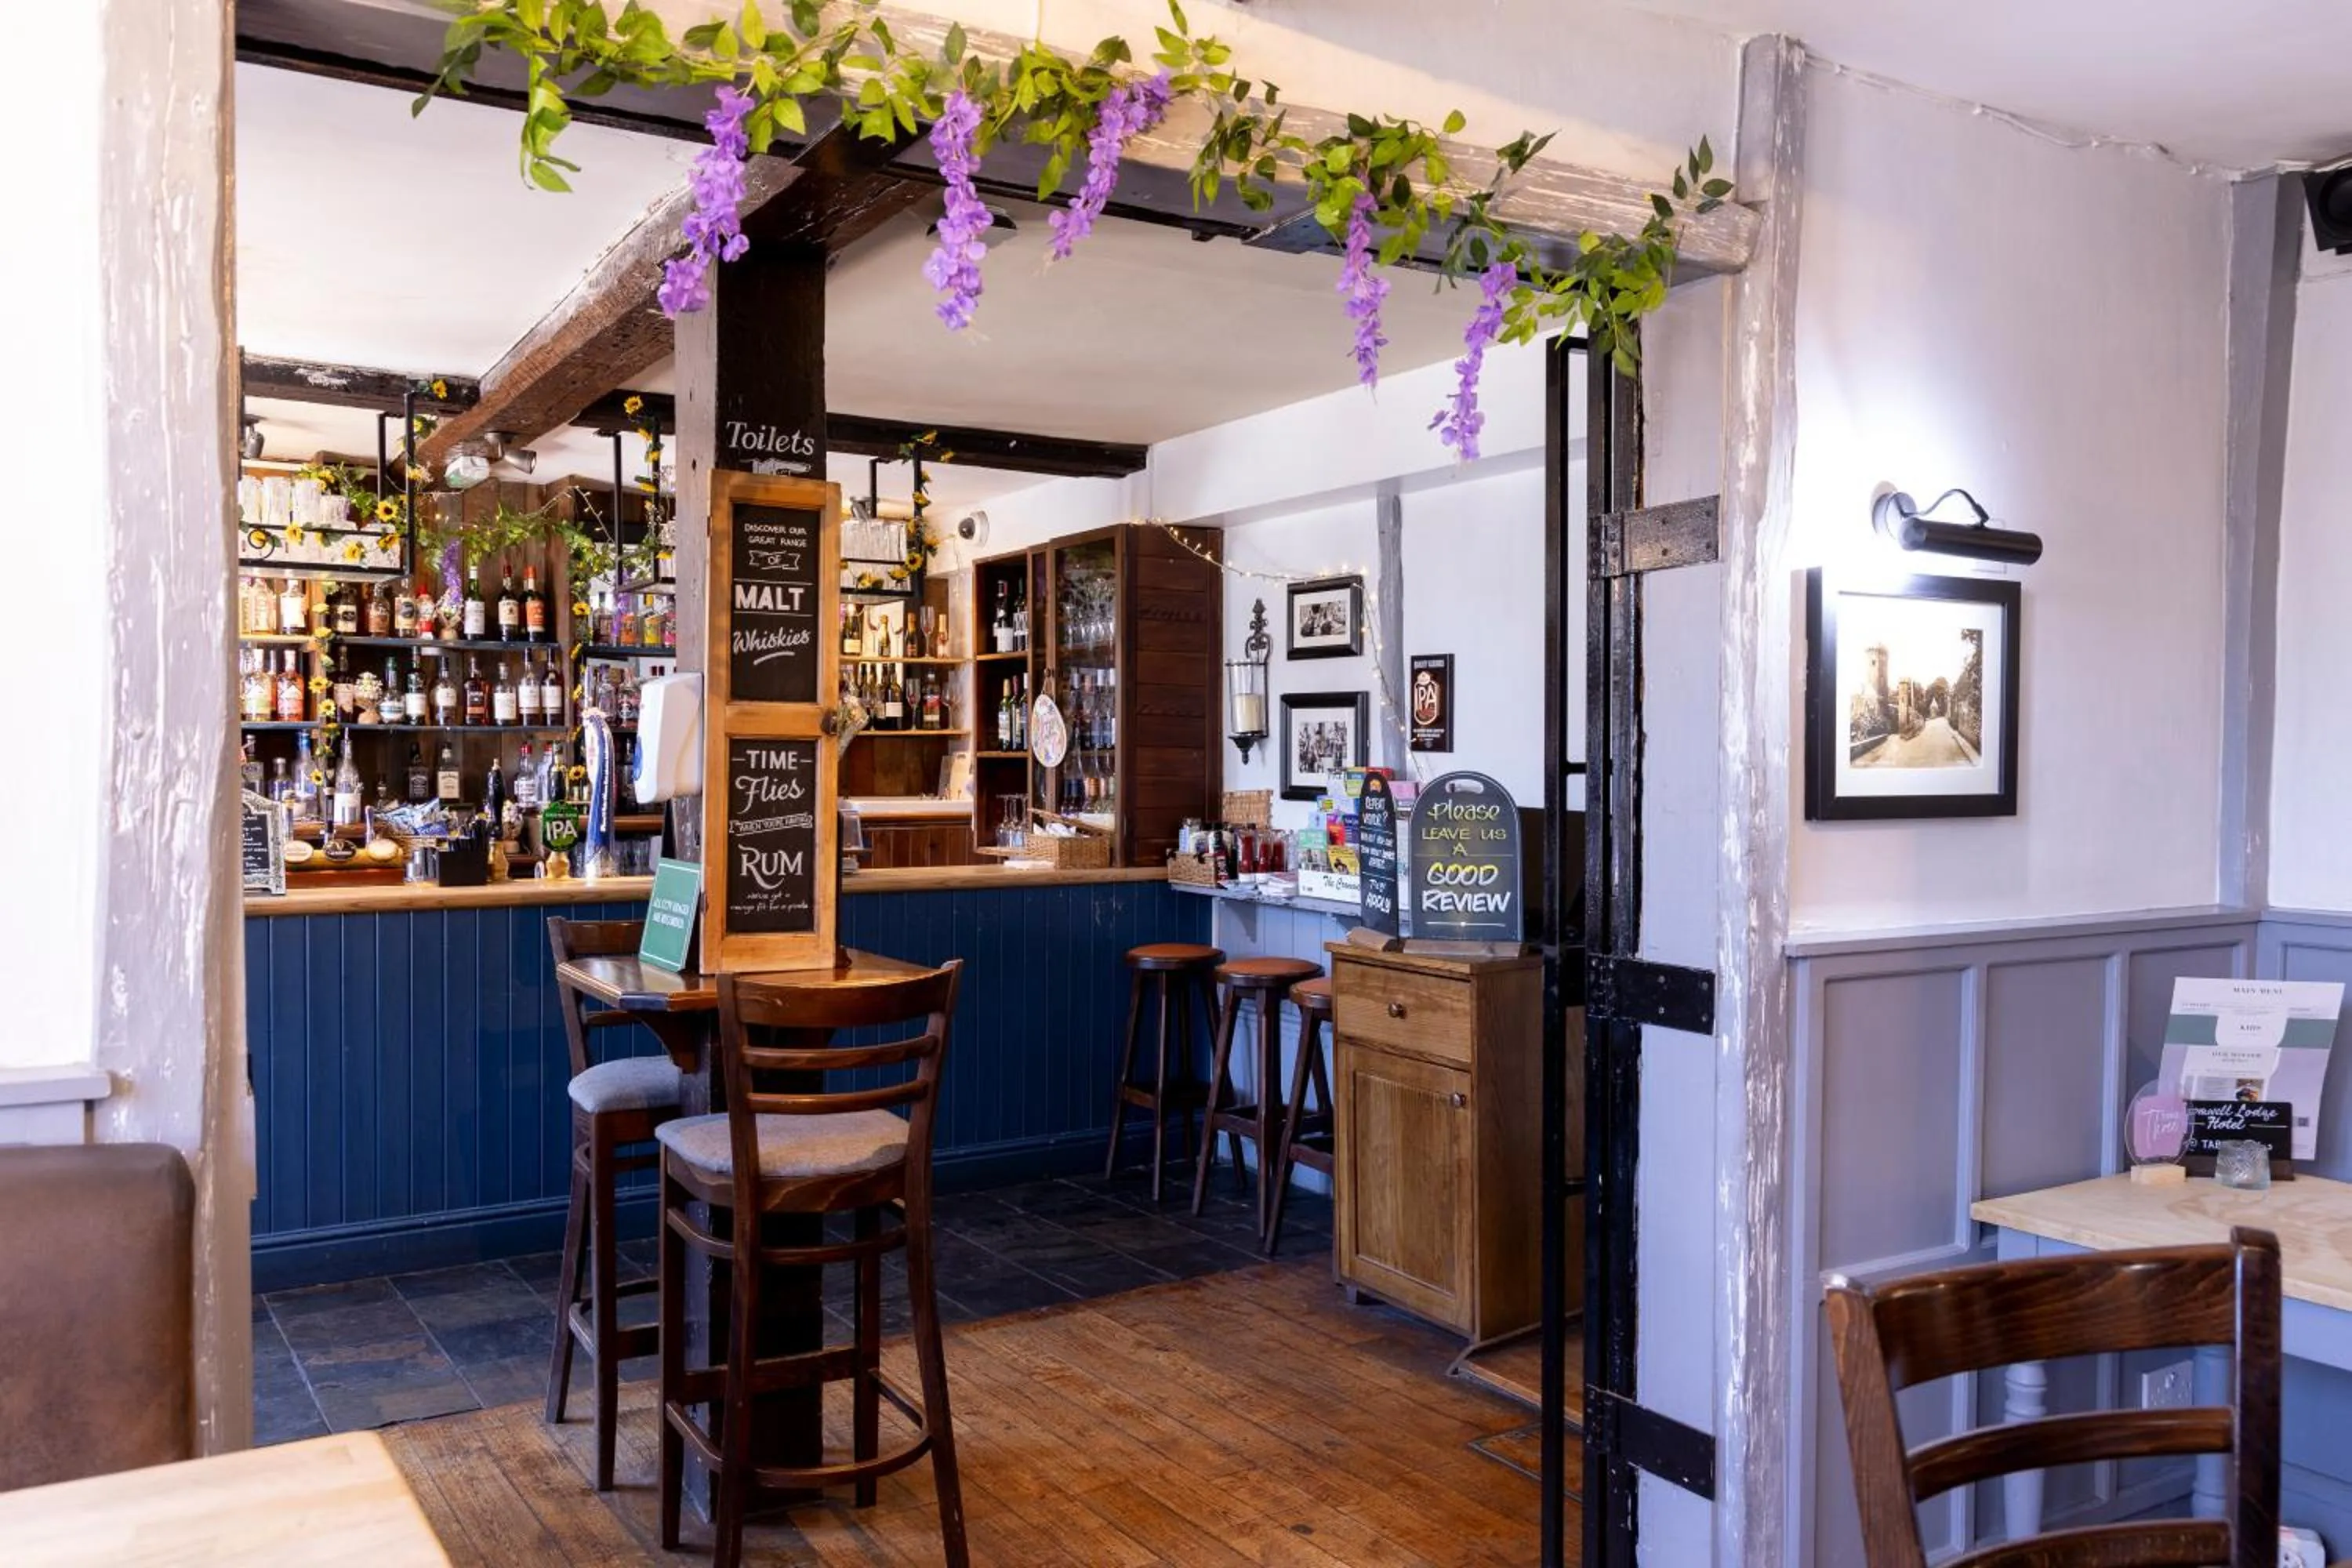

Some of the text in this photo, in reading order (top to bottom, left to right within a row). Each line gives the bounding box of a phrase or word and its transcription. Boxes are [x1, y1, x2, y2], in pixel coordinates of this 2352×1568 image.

[726, 421, 815, 455] Toilets
[744, 523, 786, 534] DISCOVER
[748, 535, 808, 548] GREAT RANGE
[768, 554, 782, 566] OF
[734, 585, 805, 612] MALT
[732, 627, 811, 654] Whiskies
[746, 750, 798, 771] TIME
[735, 775, 806, 815] Flies
[1427, 797, 1501, 822] Please
[546, 819, 578, 841] IPA
[1421, 827, 1507, 840] LEAVE US
[1451, 841, 1468, 856] A
[738, 844, 804, 891] RUM
[1426, 861, 1498, 887] GOOD
[1421, 889, 1512, 913] REVIEW
[2205, 1116, 2247, 1131] Hotel
[2234, 1103, 2280, 1123] Lodge
